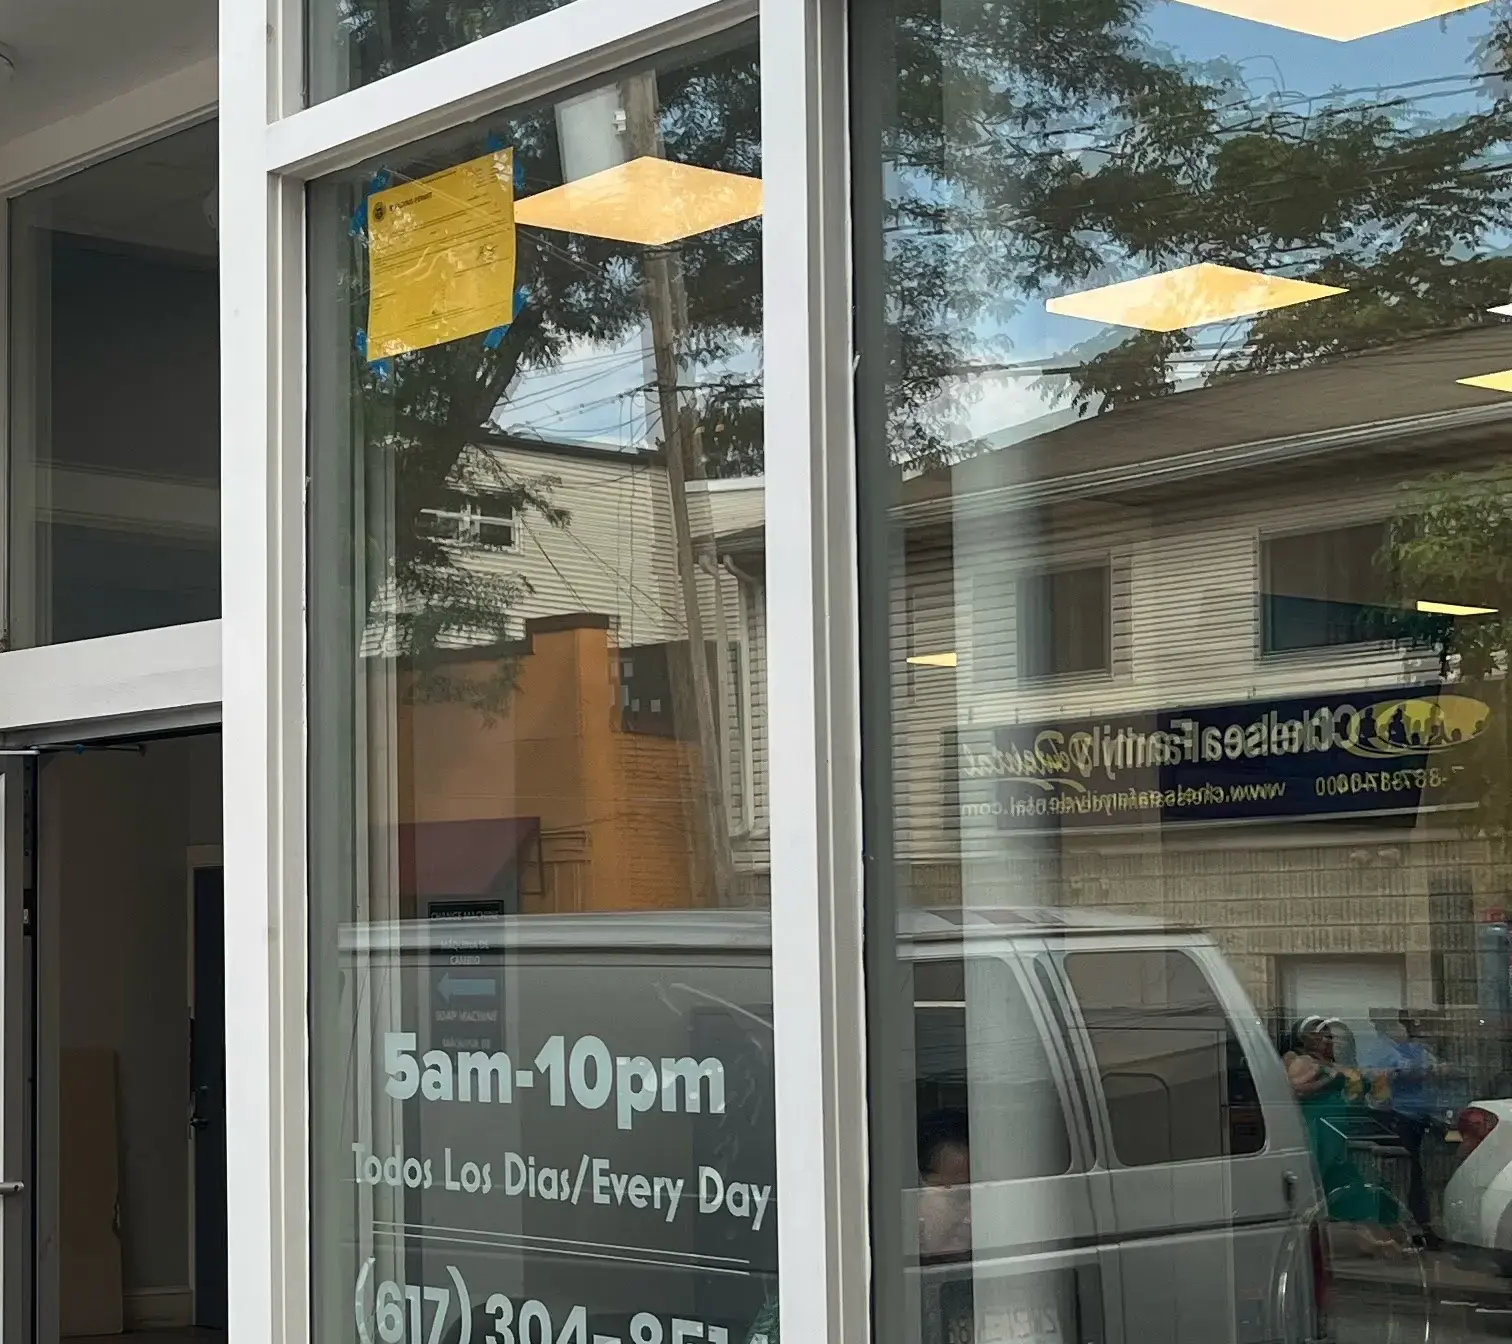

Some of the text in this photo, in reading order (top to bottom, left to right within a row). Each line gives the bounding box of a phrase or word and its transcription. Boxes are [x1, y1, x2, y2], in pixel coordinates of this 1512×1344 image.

[384, 1032, 726, 1129] 5am-10pm
[352, 1143, 433, 1190] Todos
[444, 1147, 492, 1194] Los
[698, 1165, 772, 1231] Day
